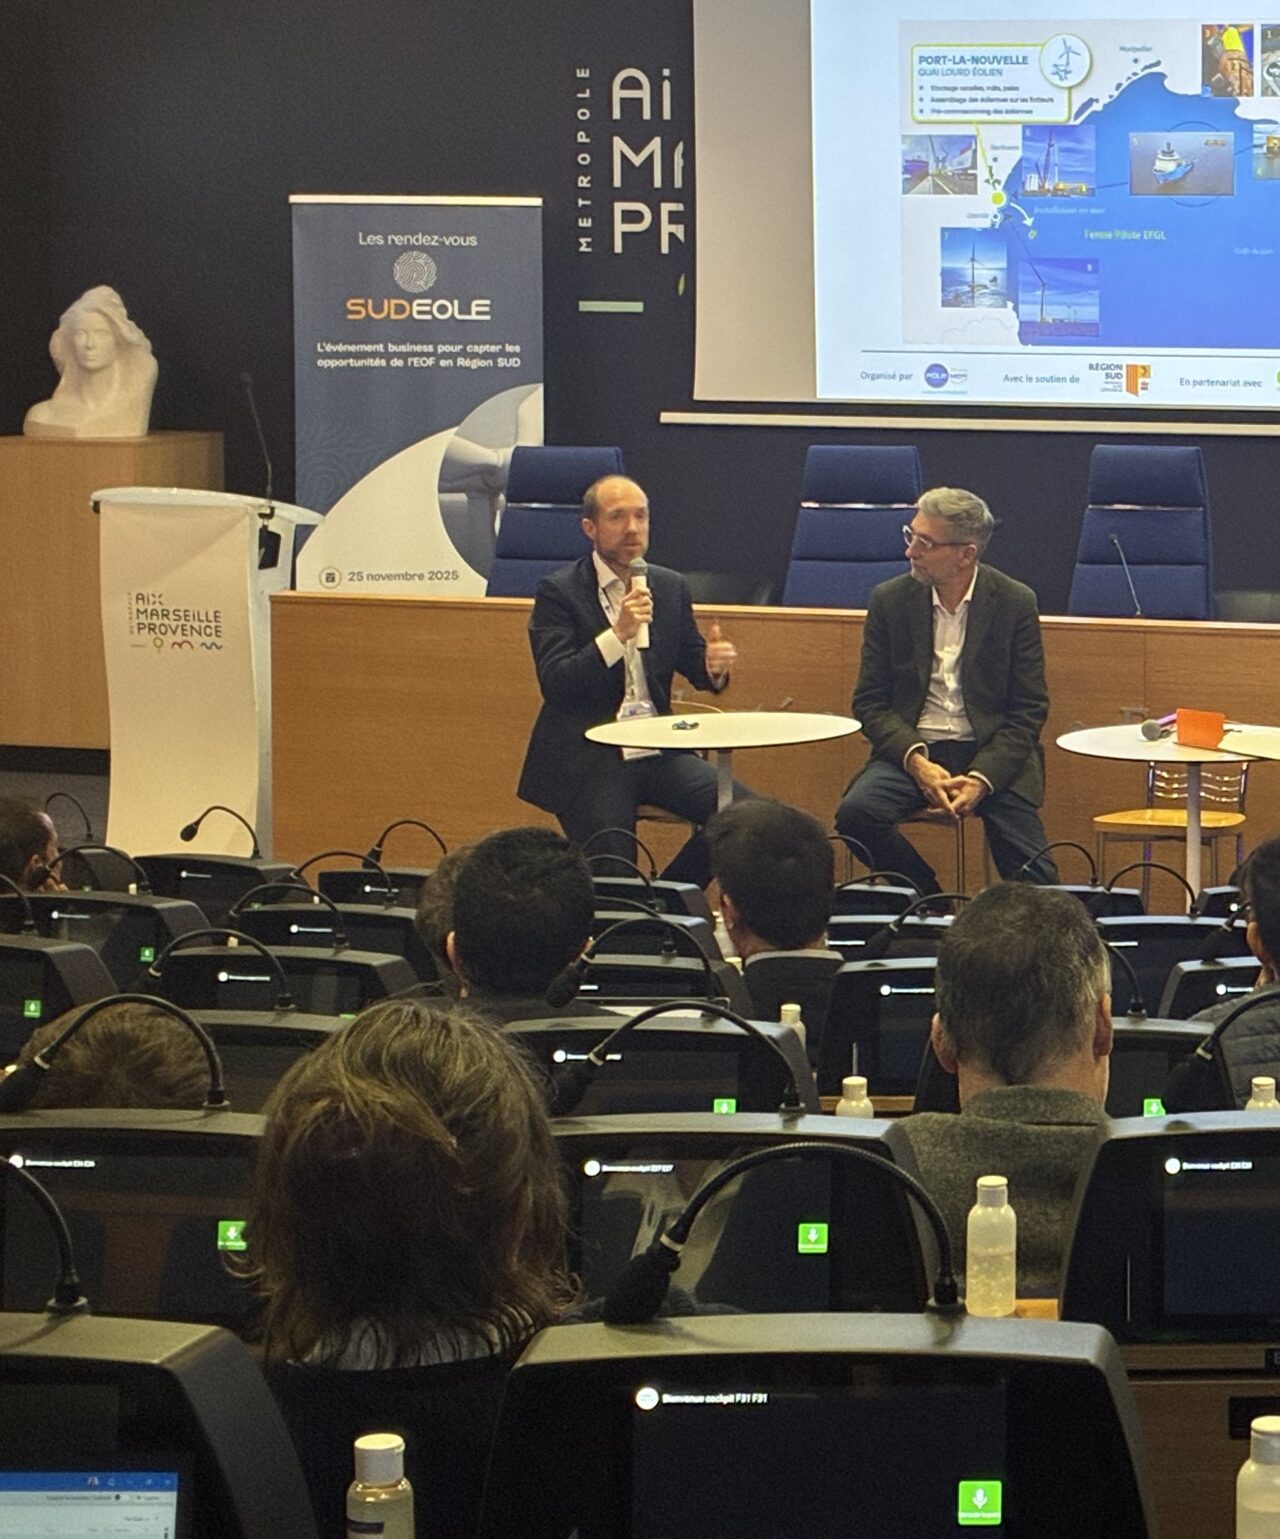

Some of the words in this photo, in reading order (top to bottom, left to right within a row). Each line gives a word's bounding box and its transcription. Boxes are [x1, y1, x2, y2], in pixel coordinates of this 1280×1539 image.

[918, 55, 1029, 65] PORT-LA-NOUVELLE
[576, 68, 593, 252] METROPOLE
[358, 232, 384, 246] Les
[387, 232, 478, 247] rendez-vous
[346, 298, 492, 321] SUDEOLE
[388, 342, 434, 353] business
[437, 344, 463, 356] pour
[466, 343, 501, 356] capter
[505, 342, 521, 353] les
[317, 356, 387, 369] opportunités
[390, 357, 404, 368] de
[439, 359, 453, 368] en
[456, 356, 493, 369] Région
[497, 357, 521, 368] SUD
[860, 370, 897, 382] Organisé
[899, 373, 913, 382] par
[1003, 374, 1023, 383] Avec
[1026, 375, 1033, 383] le
[1035, 375, 1066, 384] soutien
[1069, 376, 1080, 384] de
[1104, 372, 1123, 380] SUD
[1179, 377, 1190, 386] En
[1192, 378, 1240, 388] partenariat
[1242, 379, 1263, 387] avec
[348, 571, 364, 582] 25
[366, 571, 424, 582] novembre
[428, 570, 459, 581] 2025
[137, 622, 222, 638] PROVENCE
[662, 1393, 704, 1404] Bienvenue
[705, 1393, 734, 1405] cockpit
[735, 1393, 751, 1404] F31
[752, 1393, 768, 1404] F31
